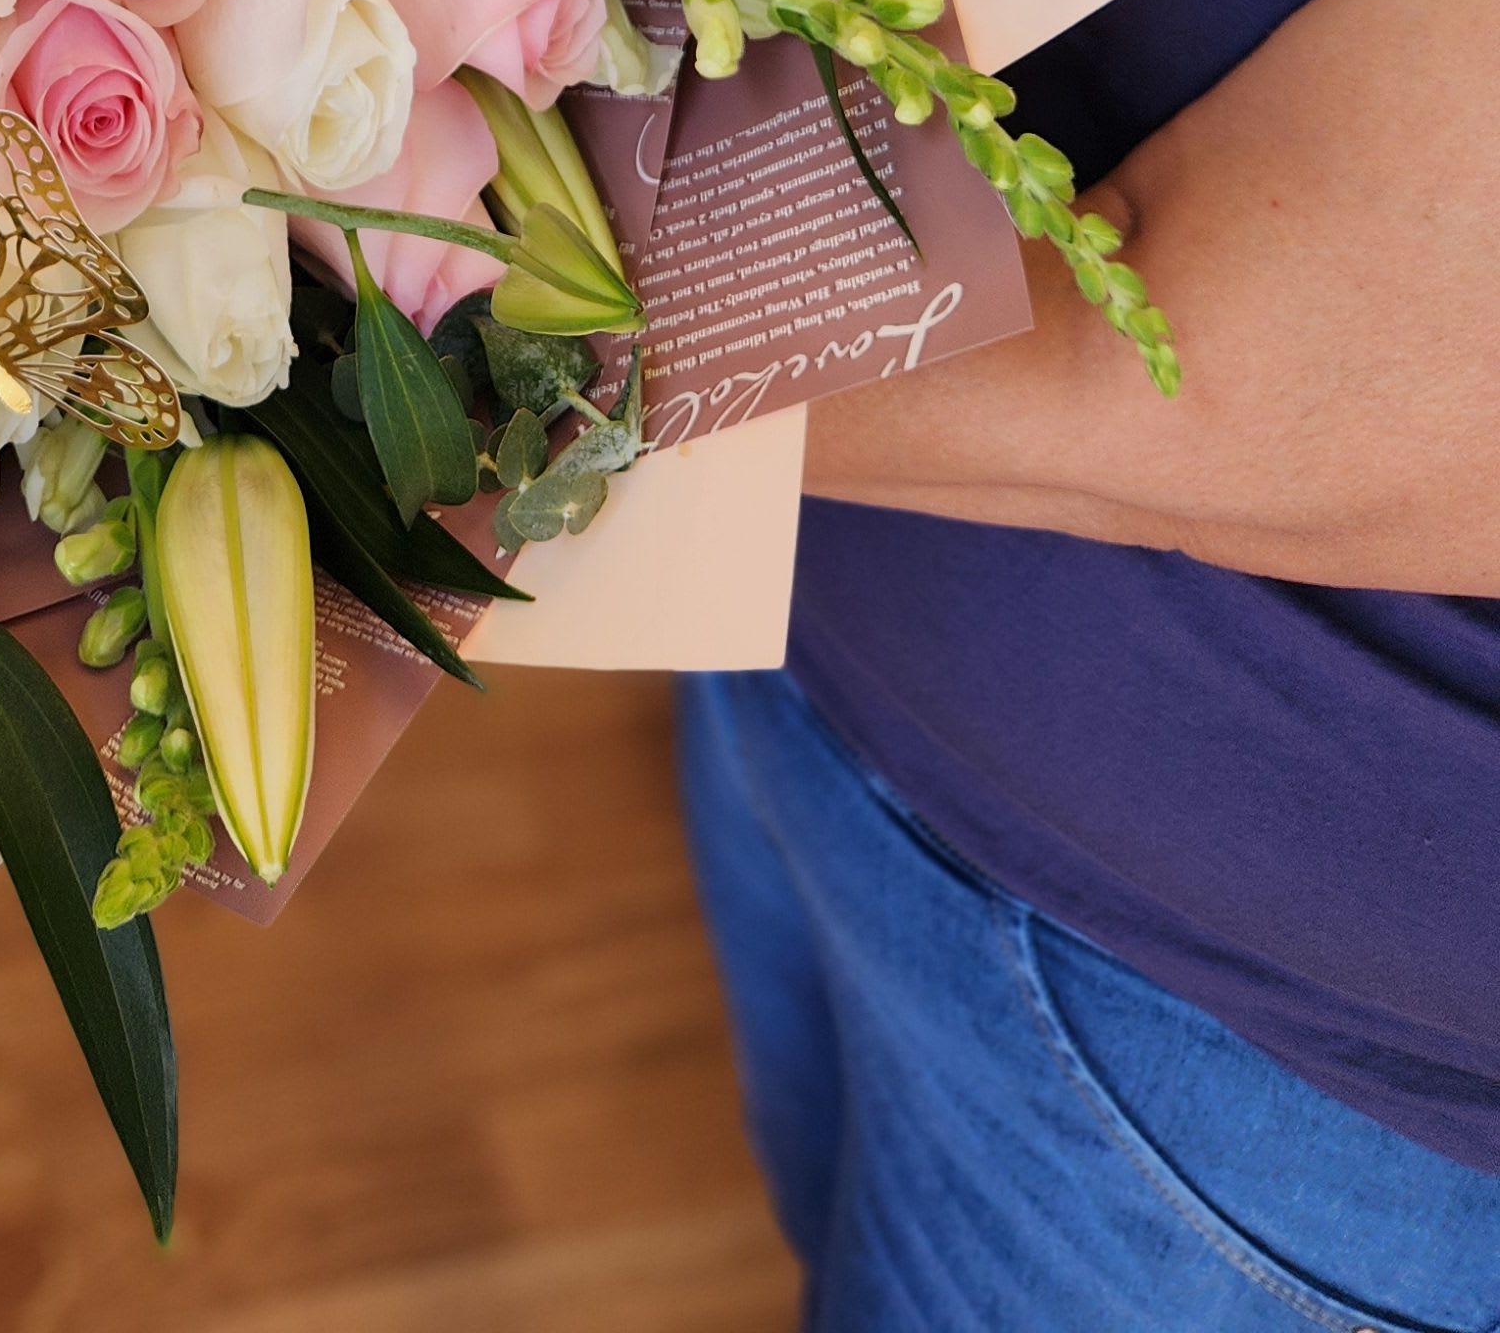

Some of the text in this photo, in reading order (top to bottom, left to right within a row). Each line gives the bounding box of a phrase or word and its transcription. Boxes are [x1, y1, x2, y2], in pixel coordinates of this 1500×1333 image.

[775, 122, 818, 147] foreign
[722, 141, 774, 169] countries
[692, 164, 721, 180] have
[717, 176, 746, 196] start
[837, 182, 851, 194] to
[672, 194, 697, 210] over
[739, 187, 775, 211] spend
[795, 188, 835, 210] escape
[698, 213, 706, 226] 2
[709, 202, 738, 220] their
[774, 204, 794, 219] the
[835, 203, 859, 219] two
[665, 218, 696, 236] week
[730, 223, 744, 237] of
[761, 213, 834, 246] unfortunate
[858, 215, 895, 239] ateful
[735, 240, 759, 255] two
[809, 228, 857, 253] feelings
[655, 246, 674, 260] the
[794, 247, 807, 262] of
[707, 271, 735, 288] man
[781, 268, 816, 286] when
[835, 264, 895, 292] watching
[671, 286, 692, 302] not
[649, 308, 695, 331] feelings
[676, 309, 763, 349] recommended
[768, 323, 793, 340] lost
[654, 339, 674, 353] the
[673, 355, 697, 372] this
[698, 346, 723, 366] and
